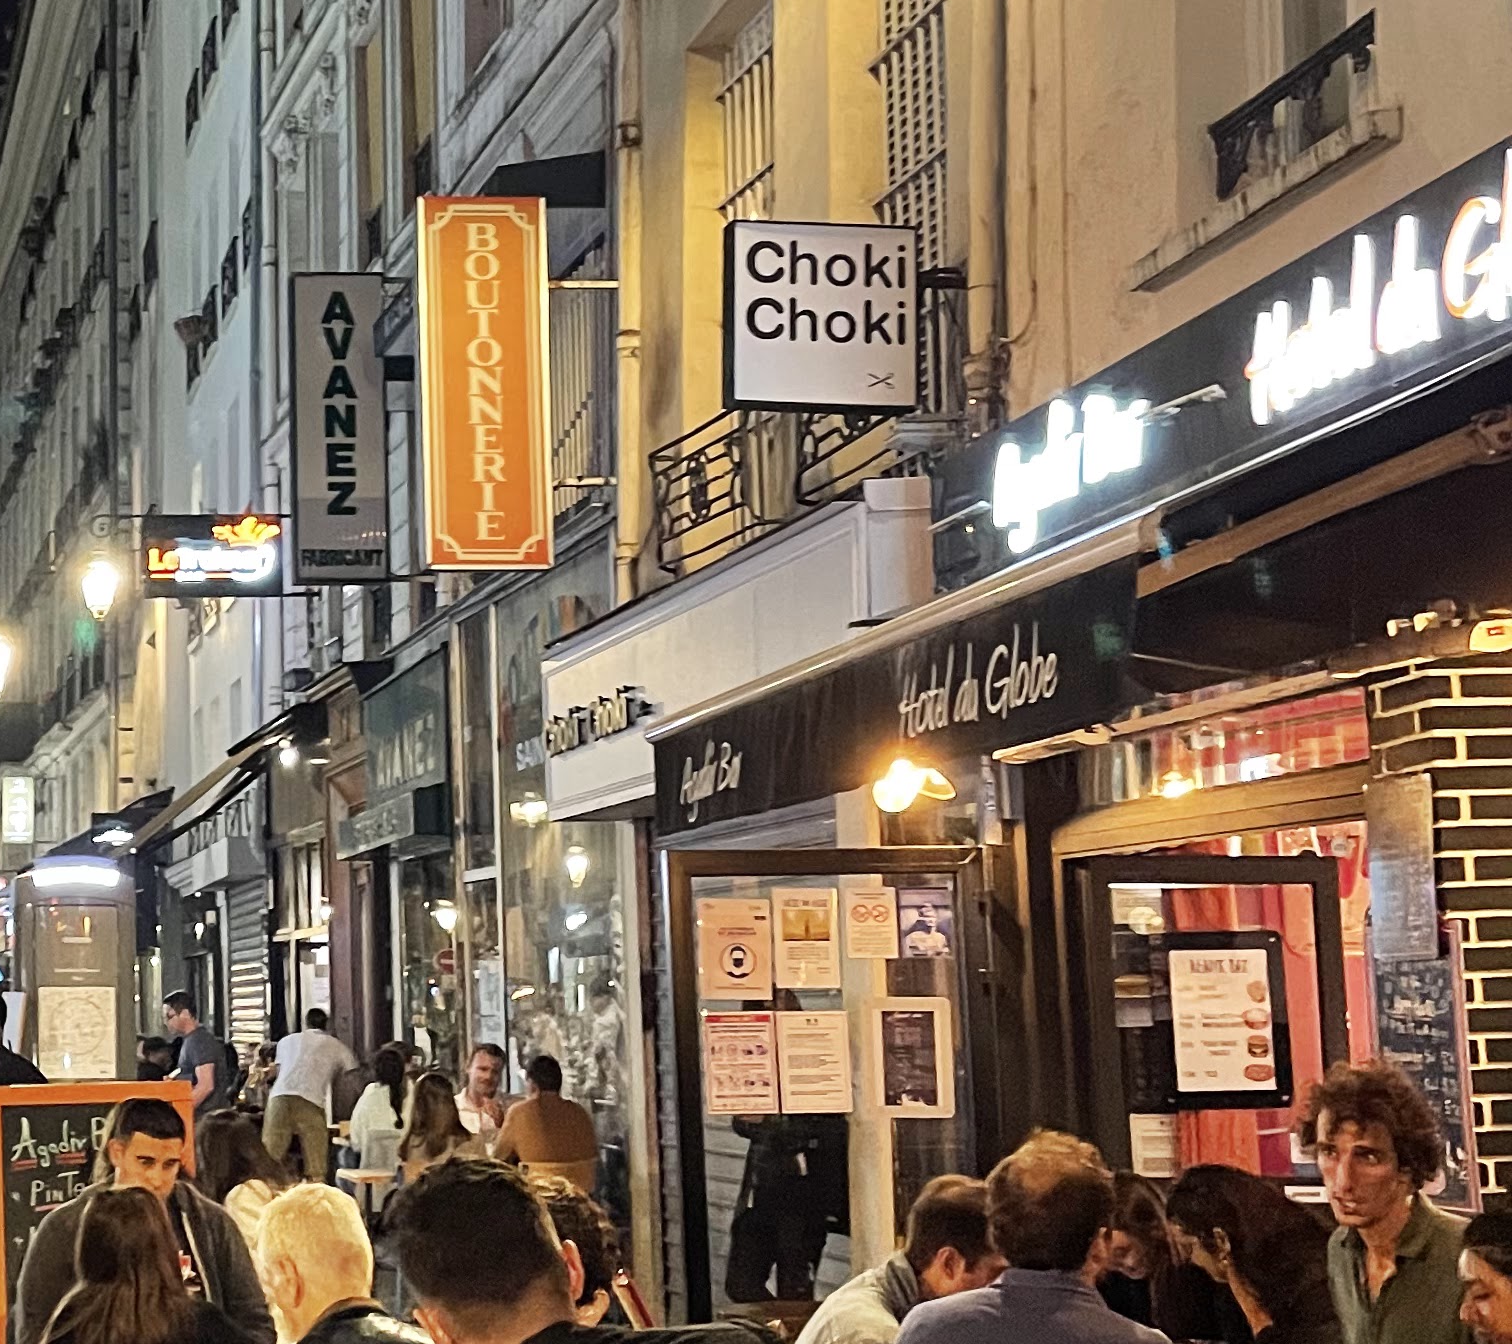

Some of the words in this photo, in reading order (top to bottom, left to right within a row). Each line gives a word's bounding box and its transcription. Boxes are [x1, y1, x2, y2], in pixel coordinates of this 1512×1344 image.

[746, 240, 907, 289] Choki
[746, 297, 907, 346] Choki
[320, 290, 359, 516] AVANEZ
[463, 222, 507, 542] BOUTONNERIE
[898, 642, 956, 738] Hotel
[985, 620, 1059, 721] Globe
[10, 1116, 88, 1167] Agadir
